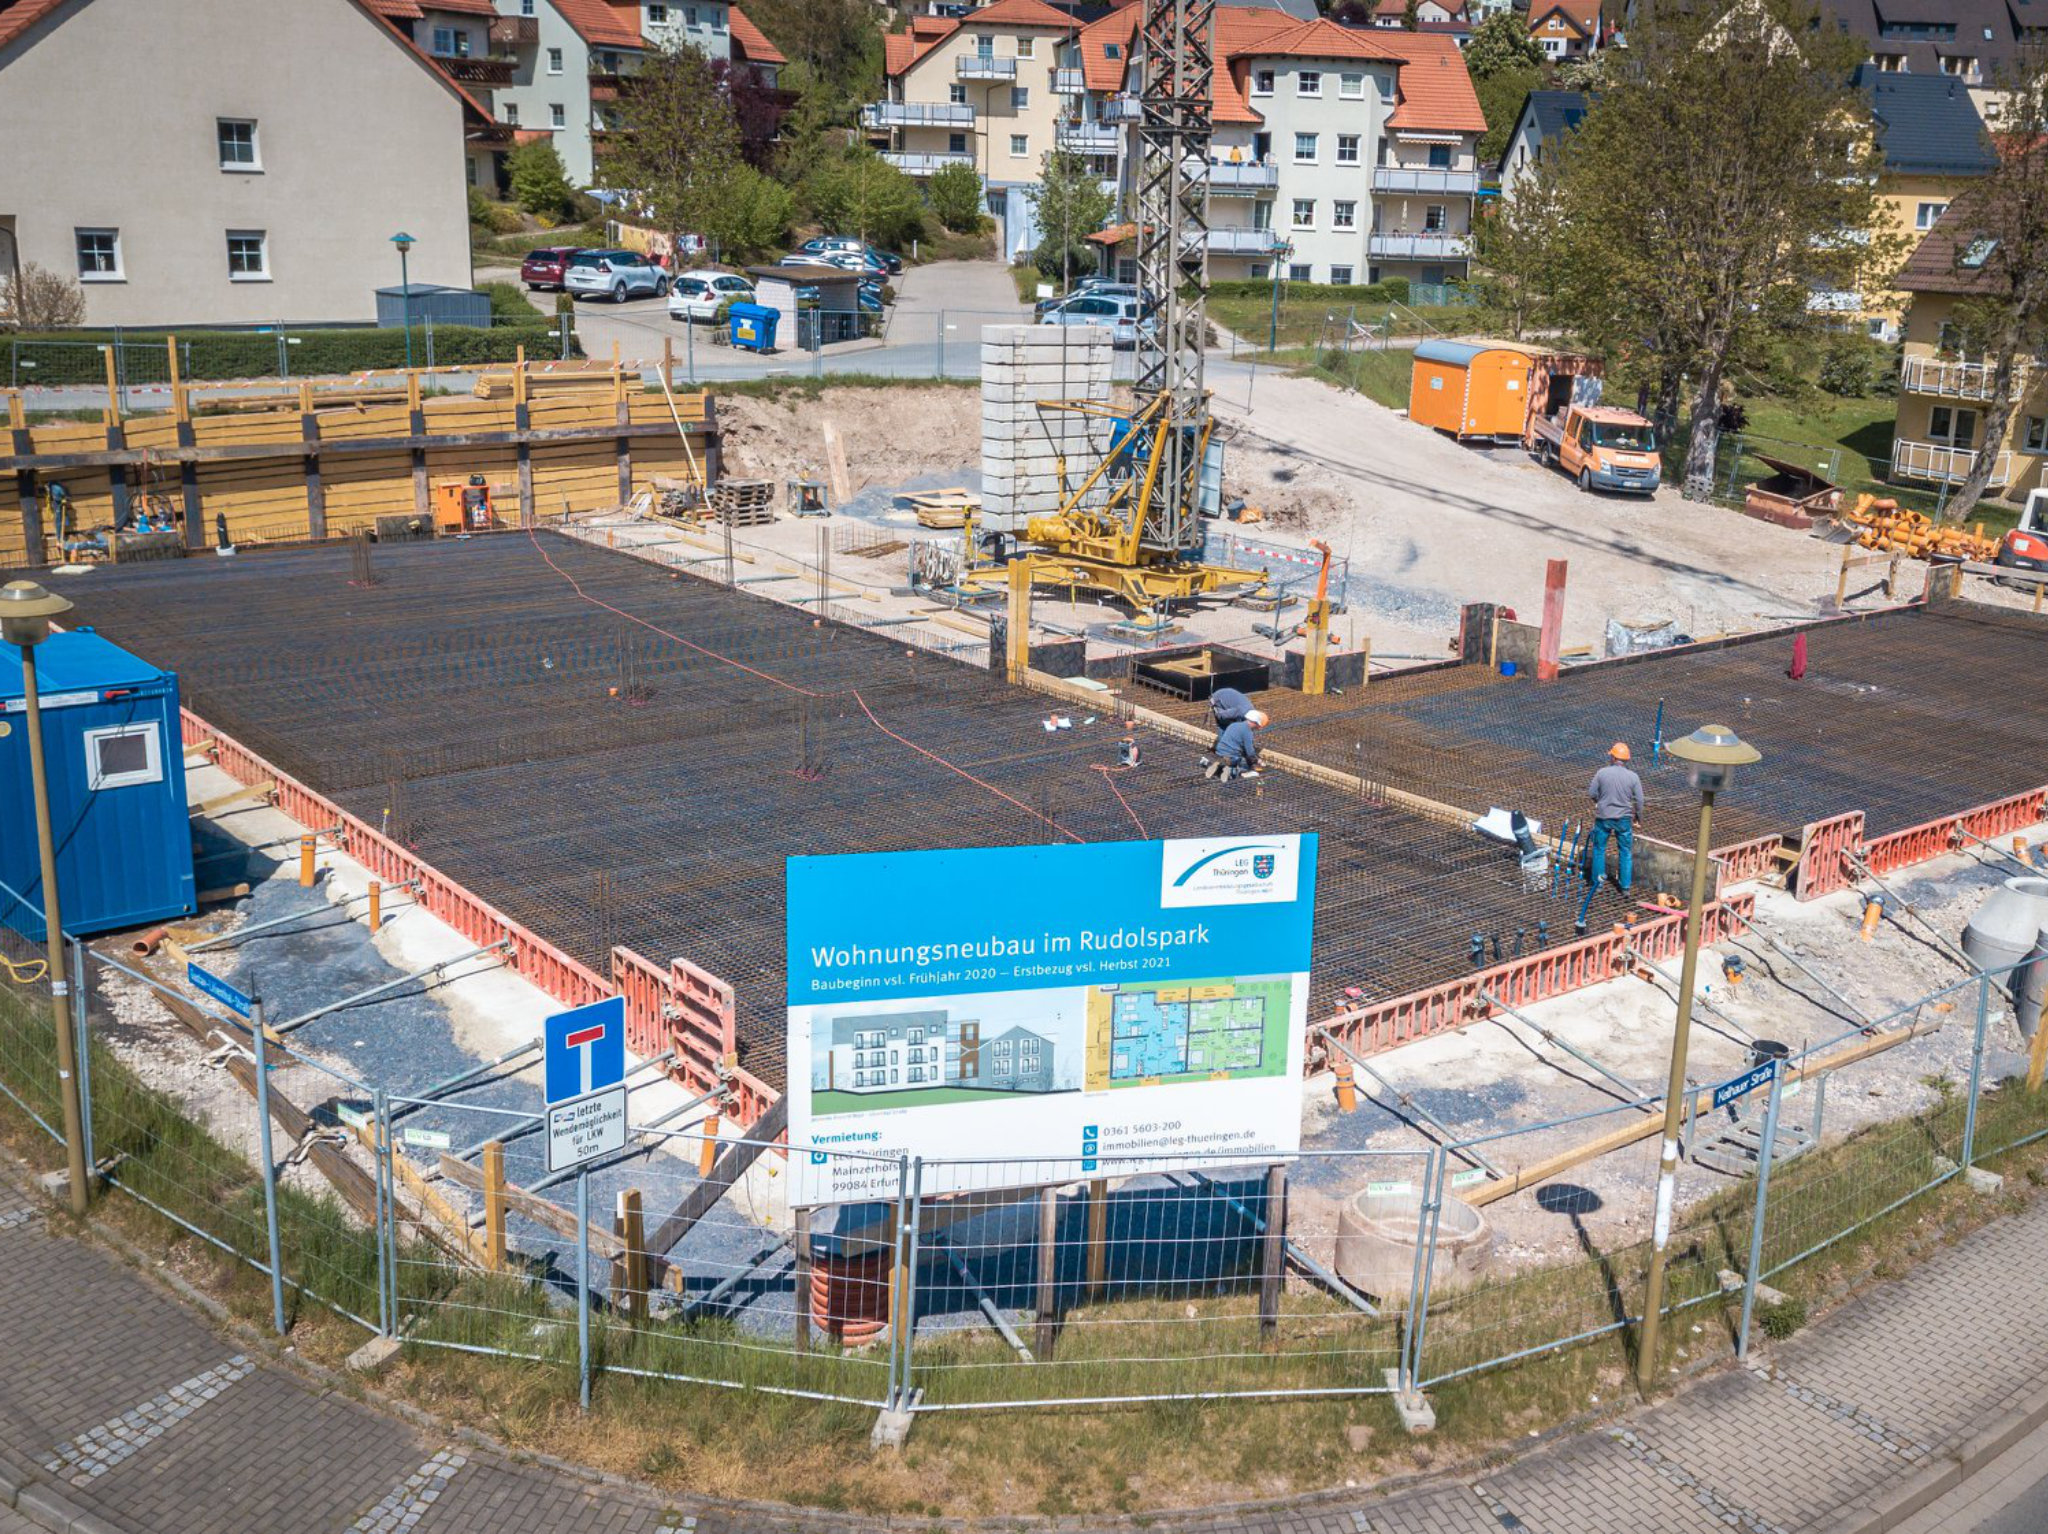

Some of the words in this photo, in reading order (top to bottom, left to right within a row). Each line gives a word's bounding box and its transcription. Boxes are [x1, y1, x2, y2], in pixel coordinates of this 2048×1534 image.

[1235, 858, 1249, 867] LEG
[811, 935, 1035, 968] Wohnungsneubau
[1043, 932, 1072, 954] im
[1080, 922, 1210, 952] Rudolspark
[811, 976, 881, 991] Baubeginn
[883, 974, 905, 986] vsl.
[909, 970, 961, 985] Frühjahr
[964, 967, 997, 981] 2020
[1013, 962, 1073, 977] Erstbezug
[1076, 960, 1096, 973] vsl.
[1100, 958, 1139, 972] Herbst
[1142, 956, 1171, 969] 2021
[577, 1102, 602, 1118] letzte
[552, 1108, 623, 1138] Wendemöglichkeit
[1103, 1124, 1129, 1137] 0361
[1132, 1120, 1182, 1134] 5603-200
[572, 1134, 584, 1146] für
[586, 1126, 604, 1141] LKW
[811, 1130, 883, 1145] Vermietung:
[1102, 1130, 1256, 1152] immobilien@leg-thueringen.de
[577, 1143, 599, 1158] 50m
[832, 1181, 868, 1193] 99084
[870, 1176, 901, 1188] Erfurt
